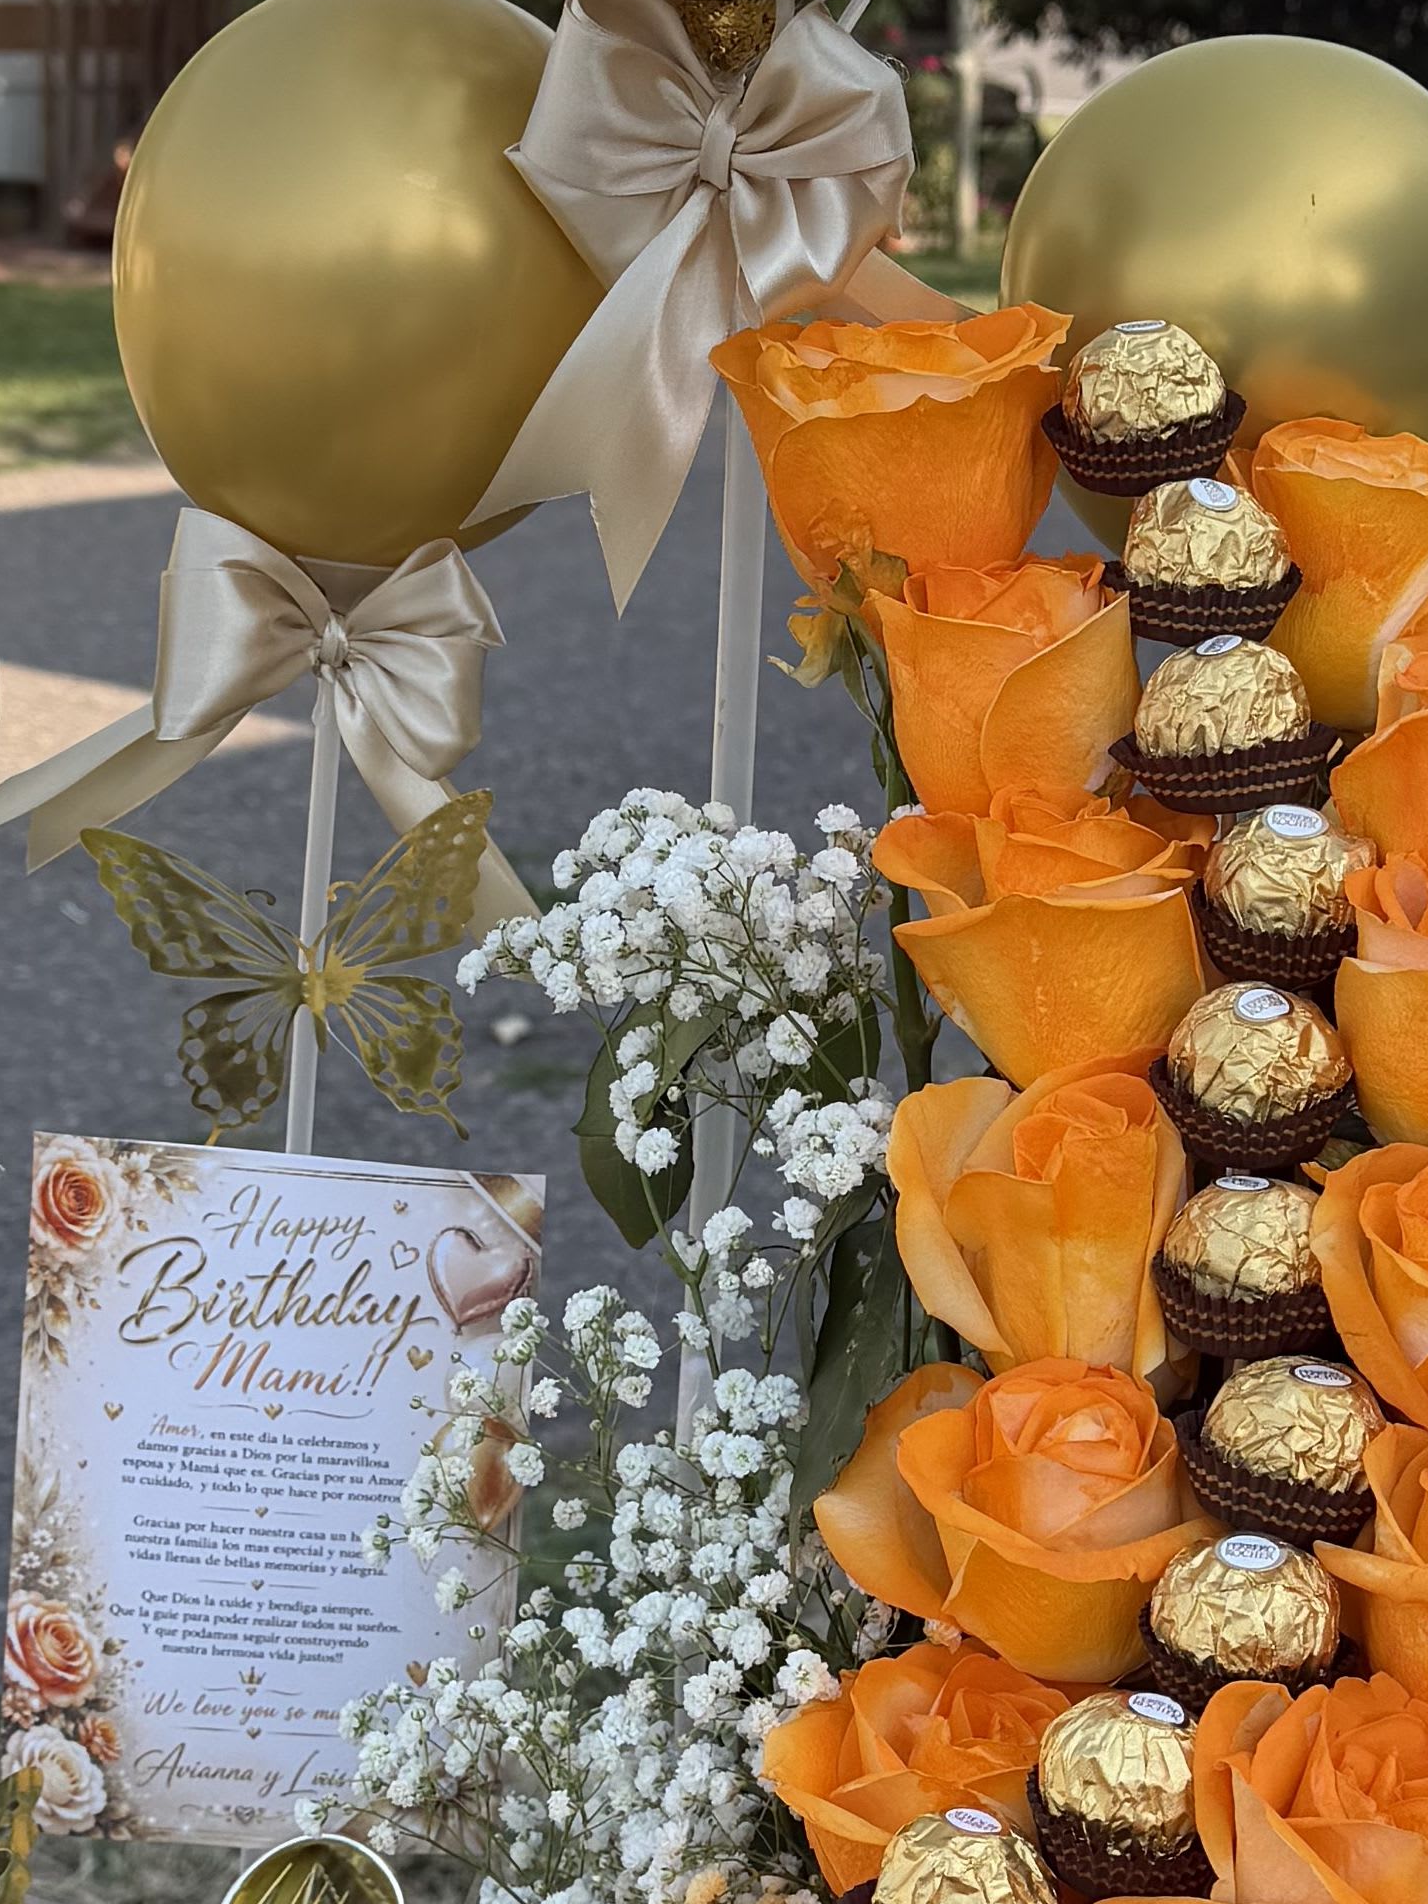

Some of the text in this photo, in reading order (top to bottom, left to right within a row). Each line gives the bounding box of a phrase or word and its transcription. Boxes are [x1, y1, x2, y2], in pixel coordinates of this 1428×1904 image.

[203, 1184, 376, 1260] Happy
[116, 1236, 439, 1358] Birthday
[143, 1689, 186, 1715] We
[193, 1693, 235, 1716] love
[240, 1705, 278, 1726] you
[284, 1707, 307, 1721] so
[133, 1742, 254, 1789] Avianna
[259, 1768, 282, 1797] y
